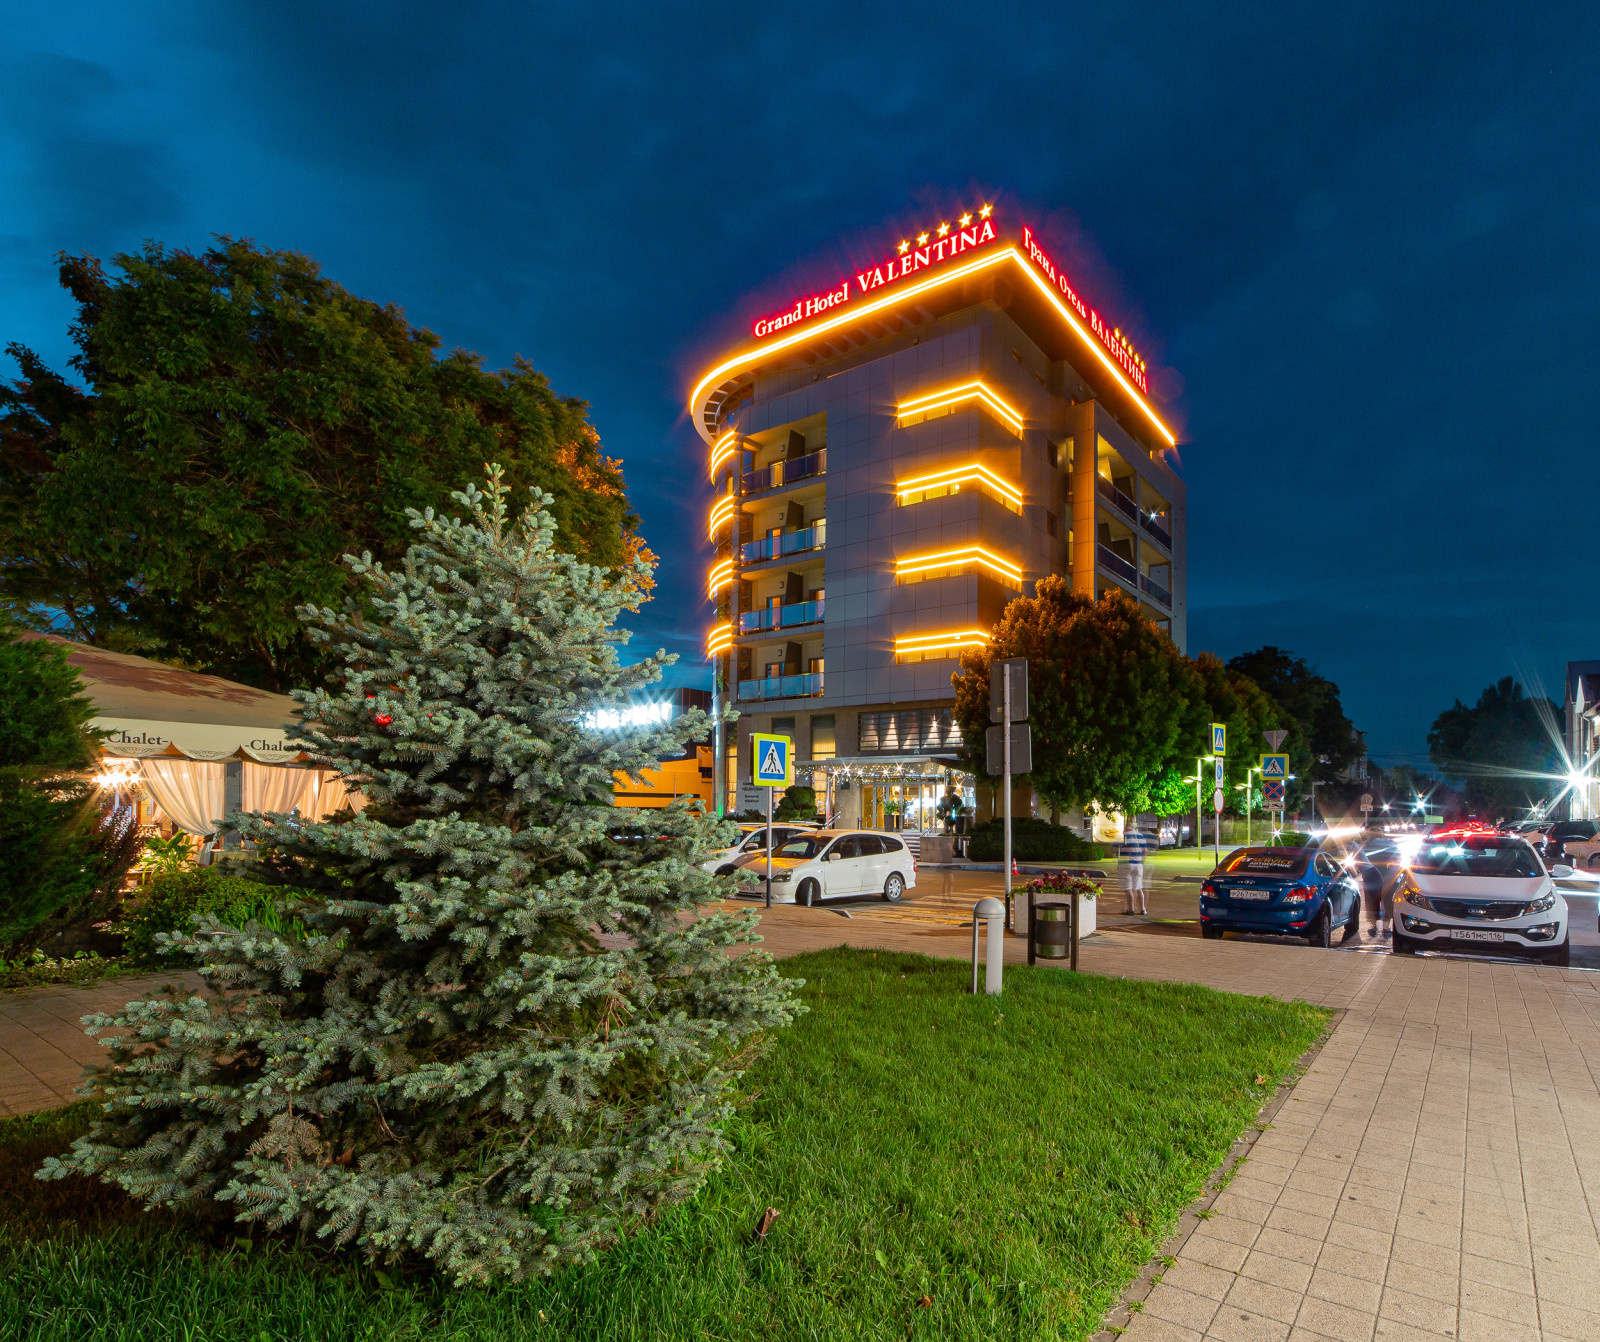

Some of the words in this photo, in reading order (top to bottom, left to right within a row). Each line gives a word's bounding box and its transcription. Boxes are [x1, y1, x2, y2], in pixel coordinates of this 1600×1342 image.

[755, 302, 802, 336] Grand
[805, 282, 849, 317] Hotel
[857, 220, 995, 292] VALENTINA
[1024, 227, 1056, 284] Гранд
[1060, 275, 1086, 319] Отель
[1091, 309, 1147, 394] ВАЛЕНТИНА
